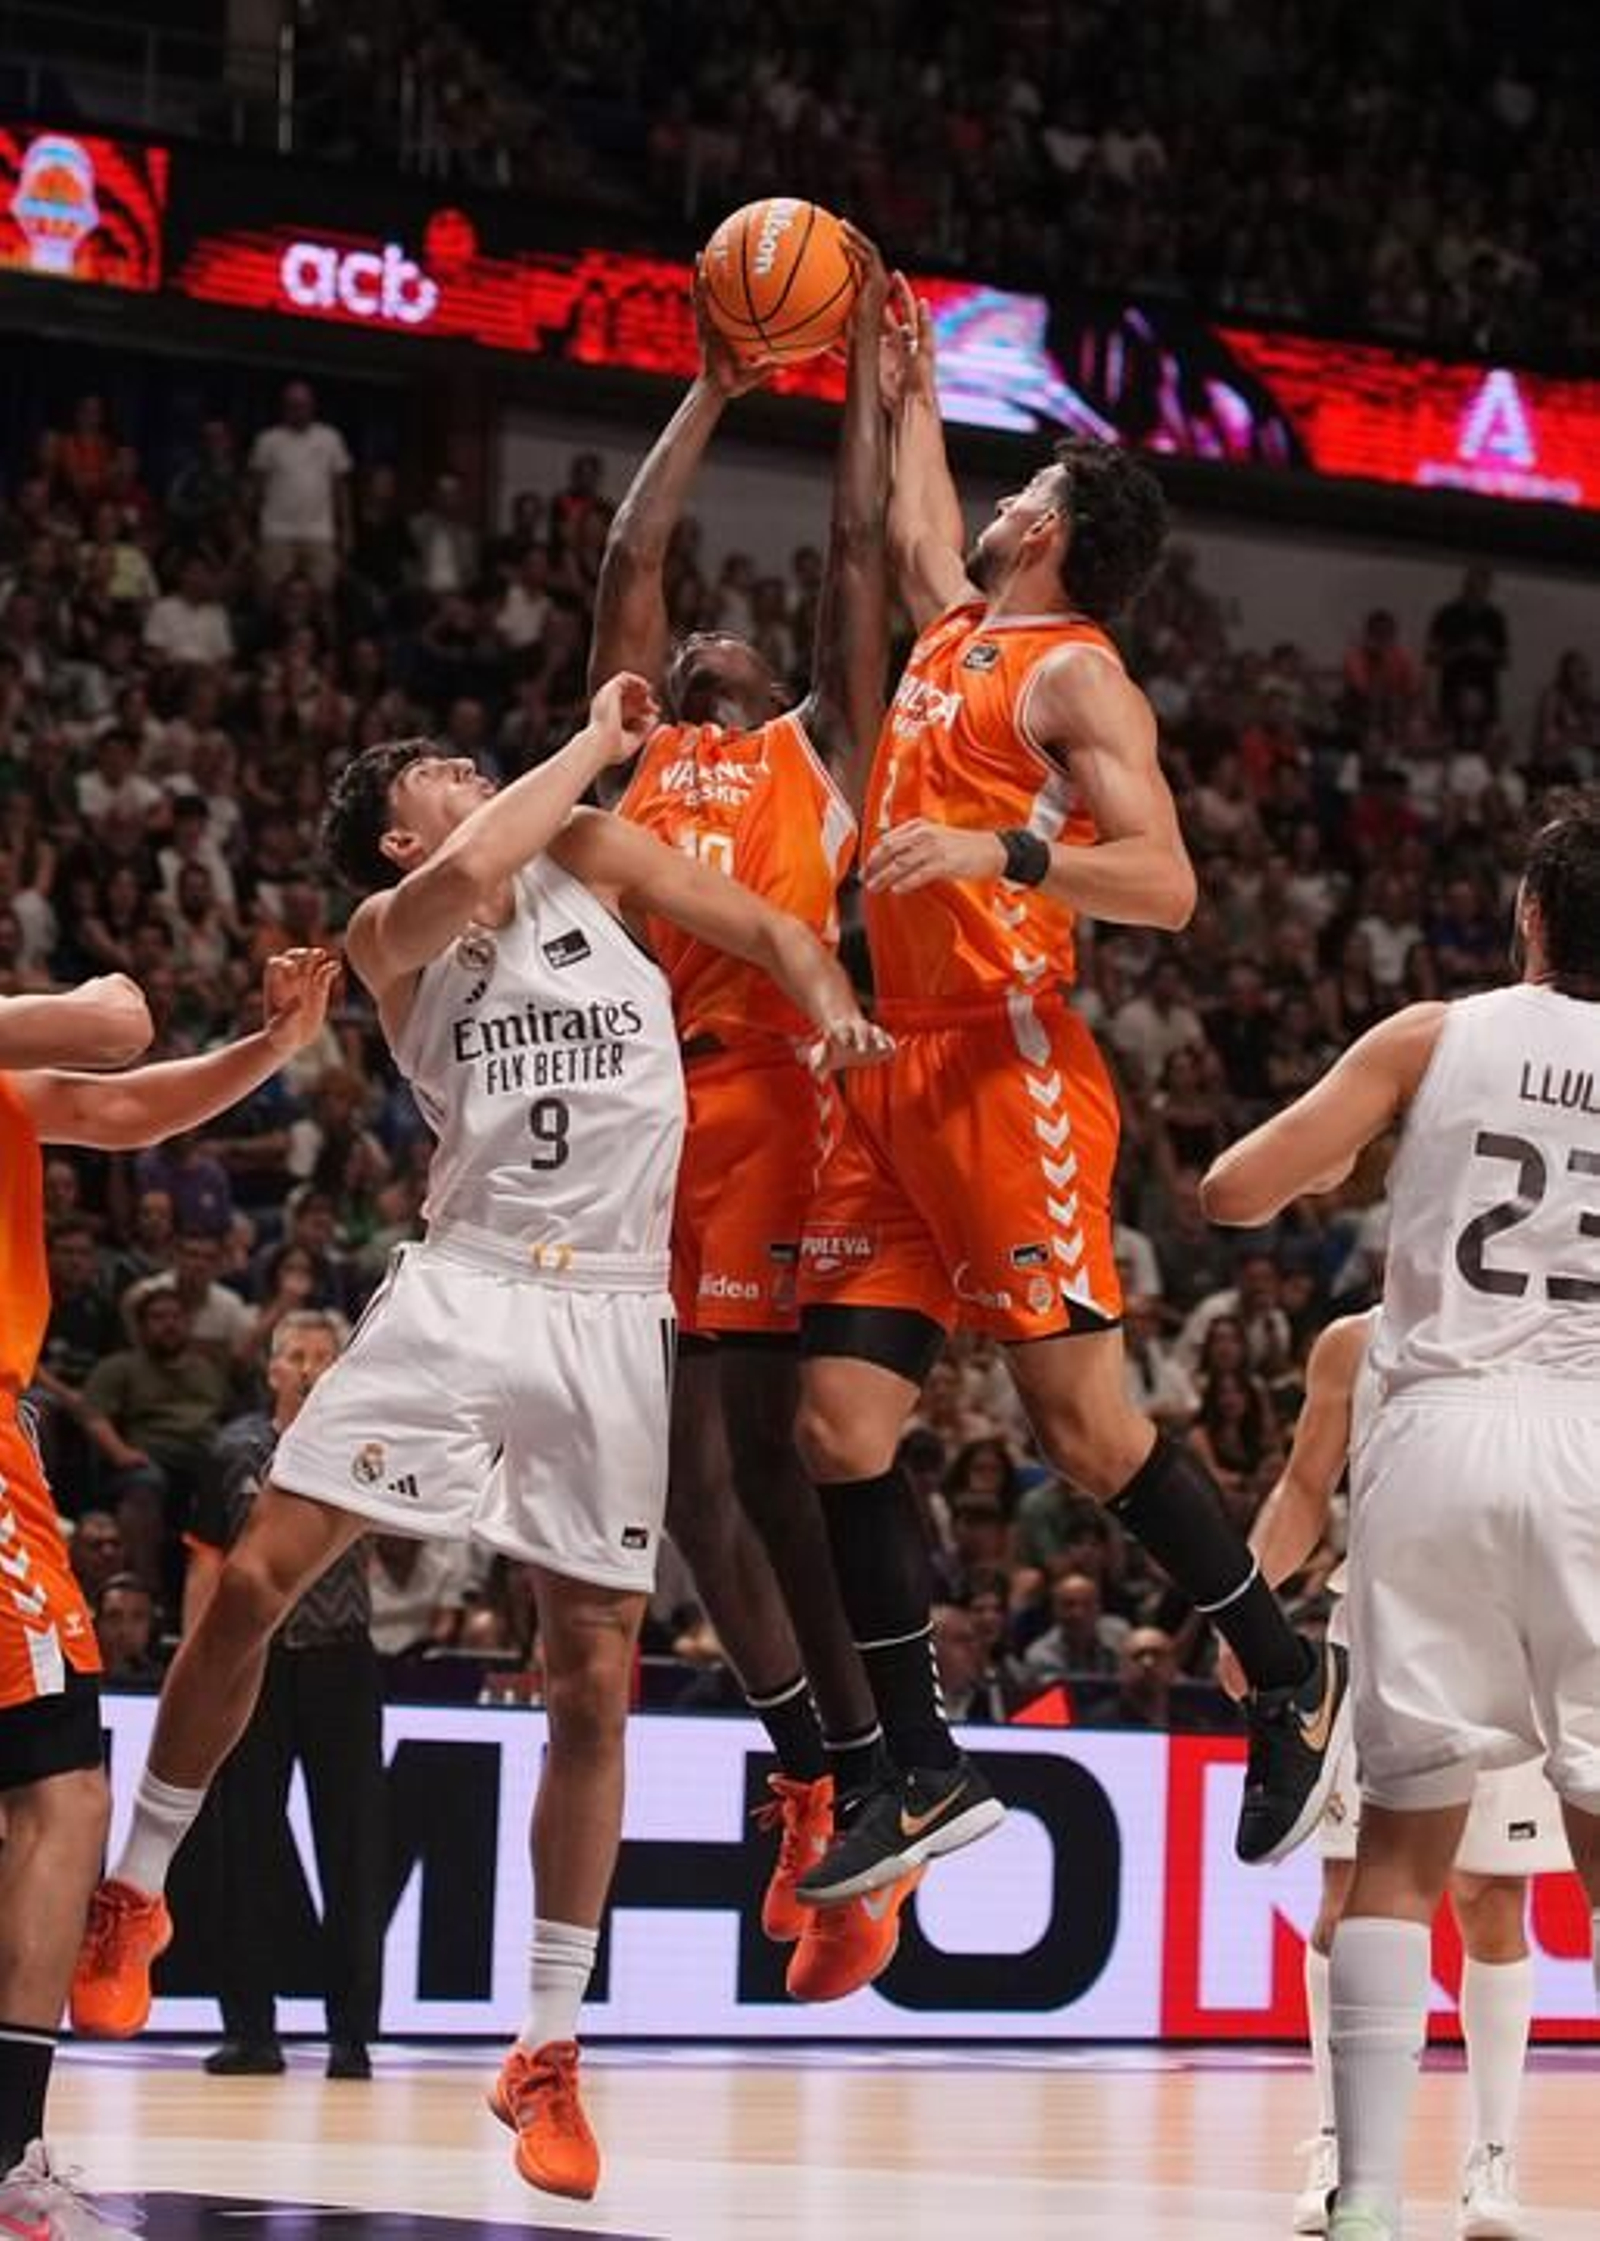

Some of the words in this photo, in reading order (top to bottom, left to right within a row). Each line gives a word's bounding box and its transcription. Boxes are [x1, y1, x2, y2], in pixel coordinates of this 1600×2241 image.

[280, 242, 439, 324] acb
[452, 1000, 643, 1063] Emirates
[486, 1052, 526, 1095] FLY
[533, 1042, 624, 1086] BETTER
[528, 1096, 571, 1171] 9
